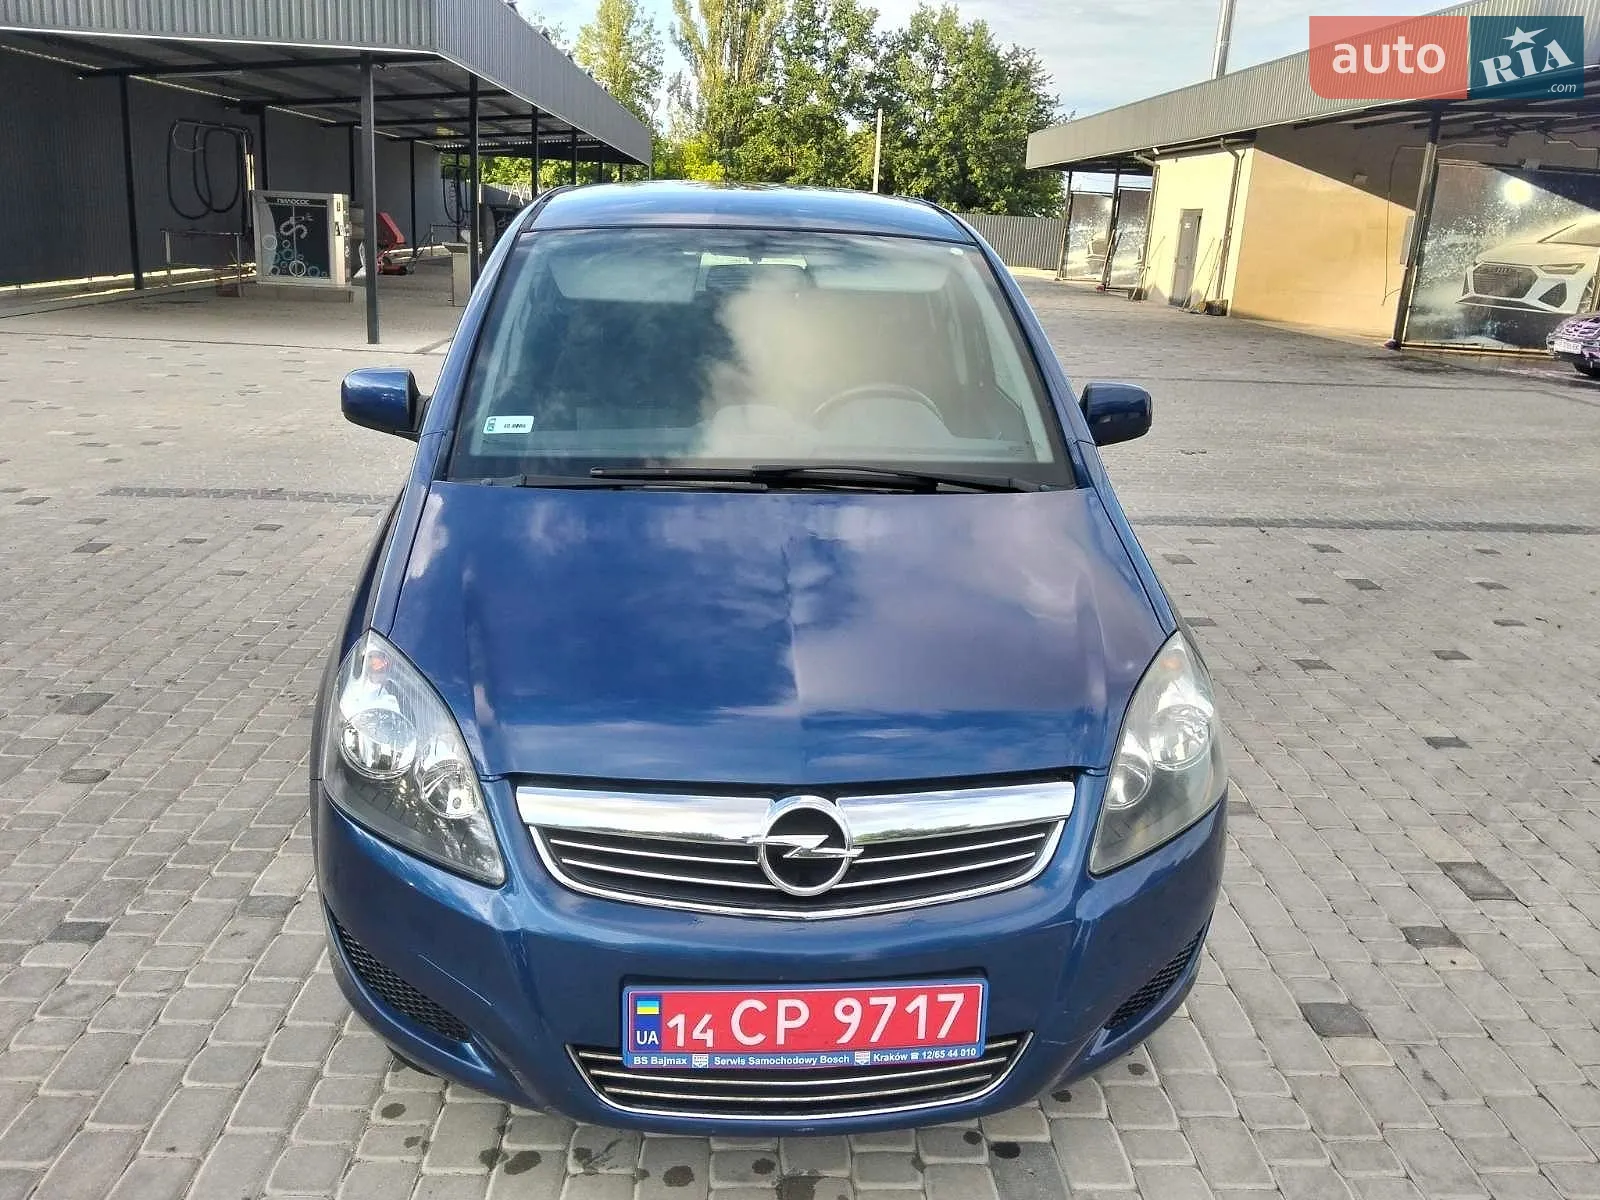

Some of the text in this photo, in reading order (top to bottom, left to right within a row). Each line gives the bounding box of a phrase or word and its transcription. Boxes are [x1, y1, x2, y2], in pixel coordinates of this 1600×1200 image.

[666, 992, 965, 1048] 14 CP 9717
[636, 1030, 660, 1046] UA
[633, 1056, 648, 1065] BS
[650, 1056, 688, 1066] Bajmax
[714, 1056, 746, 1066] Serwis
[748, 1055, 818, 1067] Samochodowy
[819, 1054, 850, 1065] Bosch
[873, 1050, 908, 1063] Kraków
[948, 1049, 959, 1058] 44
[960, 1047, 977, 1057] 010
